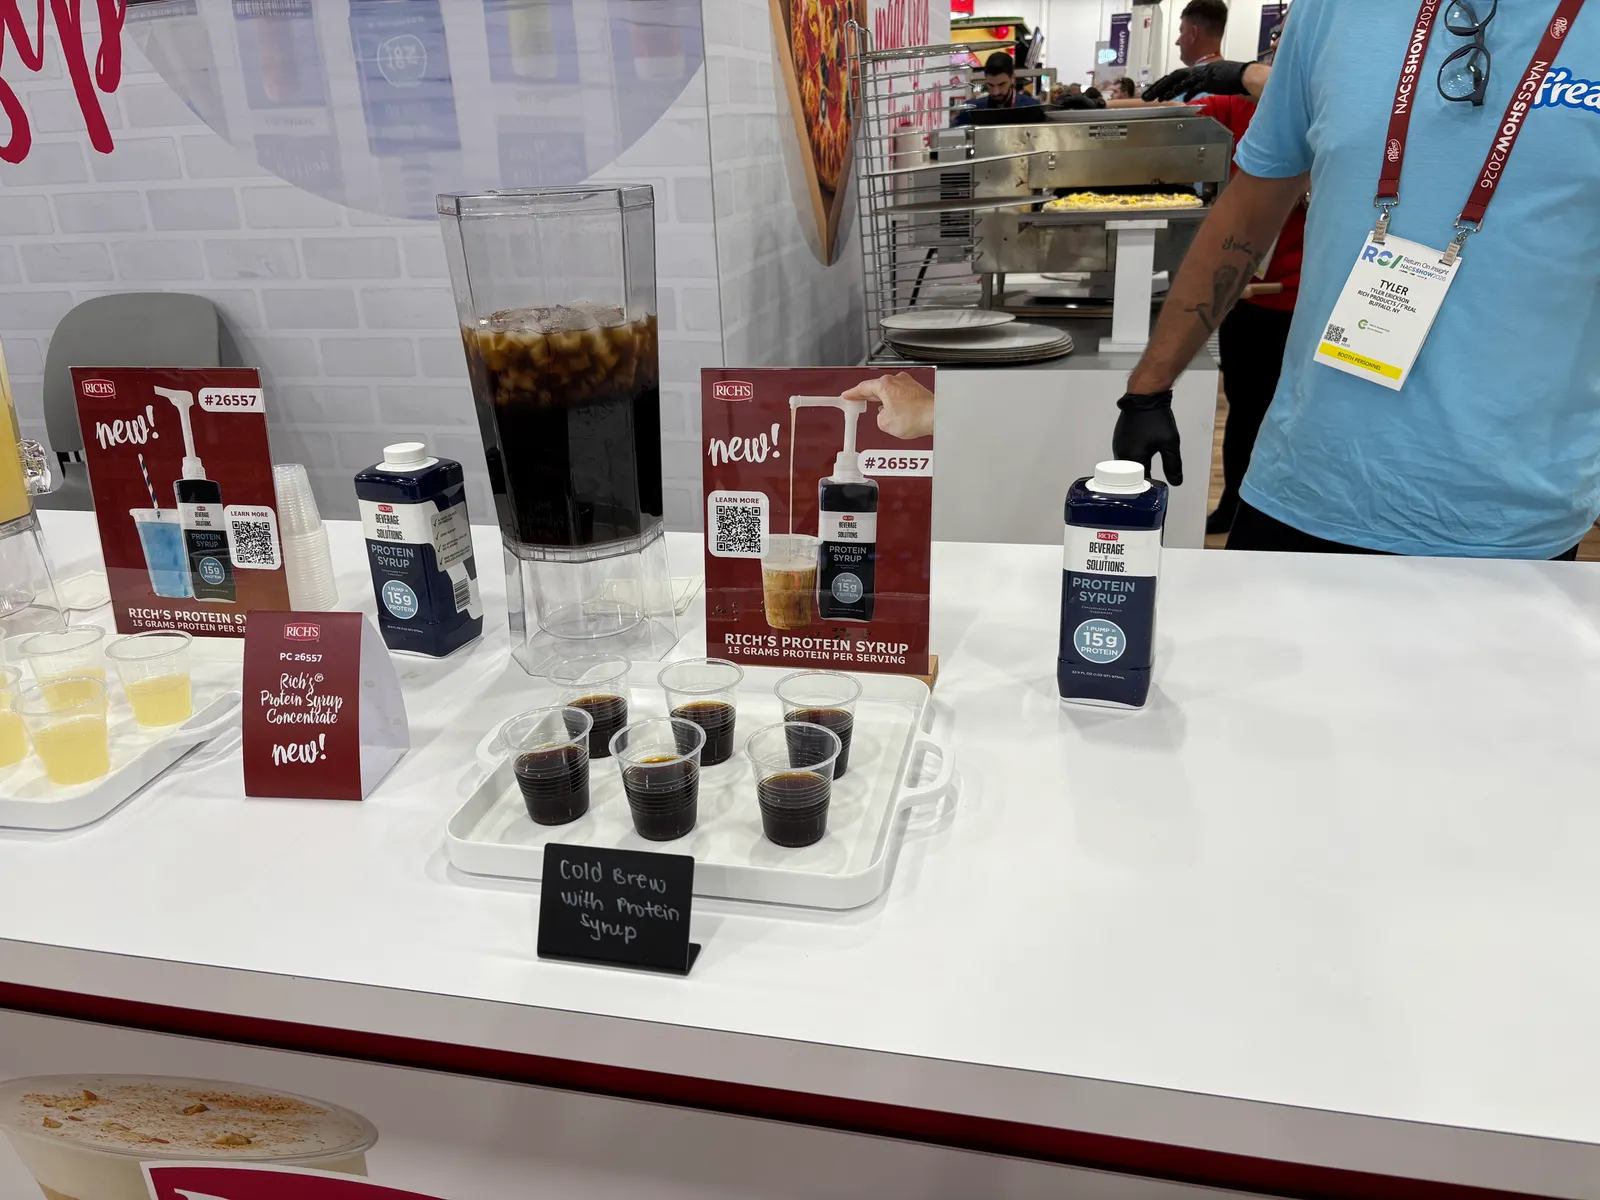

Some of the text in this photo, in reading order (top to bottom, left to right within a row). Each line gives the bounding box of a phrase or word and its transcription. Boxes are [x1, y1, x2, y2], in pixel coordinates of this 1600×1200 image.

[1380, 280, 1409, 296] TYLER
[1370, 288, 1410, 304] TYLER ERICKSON
[1370, 294, 1396, 306] PRODUCTS
[1337, 352, 1381, 370] BOOTH PERSONNEL
[84, 382, 114, 394] RICH'S
[716, 384, 751, 397] RICH'S
[204, 394, 257, 406] #26557
[96, 404, 159, 450] new!
[708, 423, 780, 467] new!
[864, 457, 929, 470] #26557
[375, 514, 400, 525] BEVERAGE
[376, 529, 403, 540] SOLUTIONS
[371, 544, 414, 557] PROTEIN
[829, 546, 867, 554] PROTEIN
[1089, 541, 1125, 555] BEVERAGE
[378, 556, 410, 568] SYRUP
[1086, 559, 1125, 572] SOLUTIONS
[204, 566, 220, 575] 15g
[838, 583, 857, 592] 15g
[1072, 577, 1136, 592] PROTEIN
[388, 591, 412, 606] 15g
[1079, 591, 1127, 605] SYRUP
[389, 604, 414, 612] PROTEIN
[128, 608, 171, 620] RICH'S
[175, 610, 231, 624] PROTEIN
[145, 620, 175, 629] GRAMS
[178, 622, 216, 631] PROTEIN
[286, 626, 318, 637] RICH'S
[725, 633, 909, 655] RICH'S PROTEIN SYRUP
[1083, 632, 1118, 648] 15g
[295, 653, 322, 662] 26557
[743, 647, 780, 657] GRAMS
[782, 650, 830, 660] PROTEIN
[833, 653, 853, 661] PER
[857, 654, 906, 664] SERVING
[1081, 646, 1118, 656] PROTEIN
[260, 690, 343, 714] Protein Syrup
[266, 708, 338, 724] Concentrate
[272, 733, 327, 766] new!
[560, 859, 666, 894] Cold Brew
